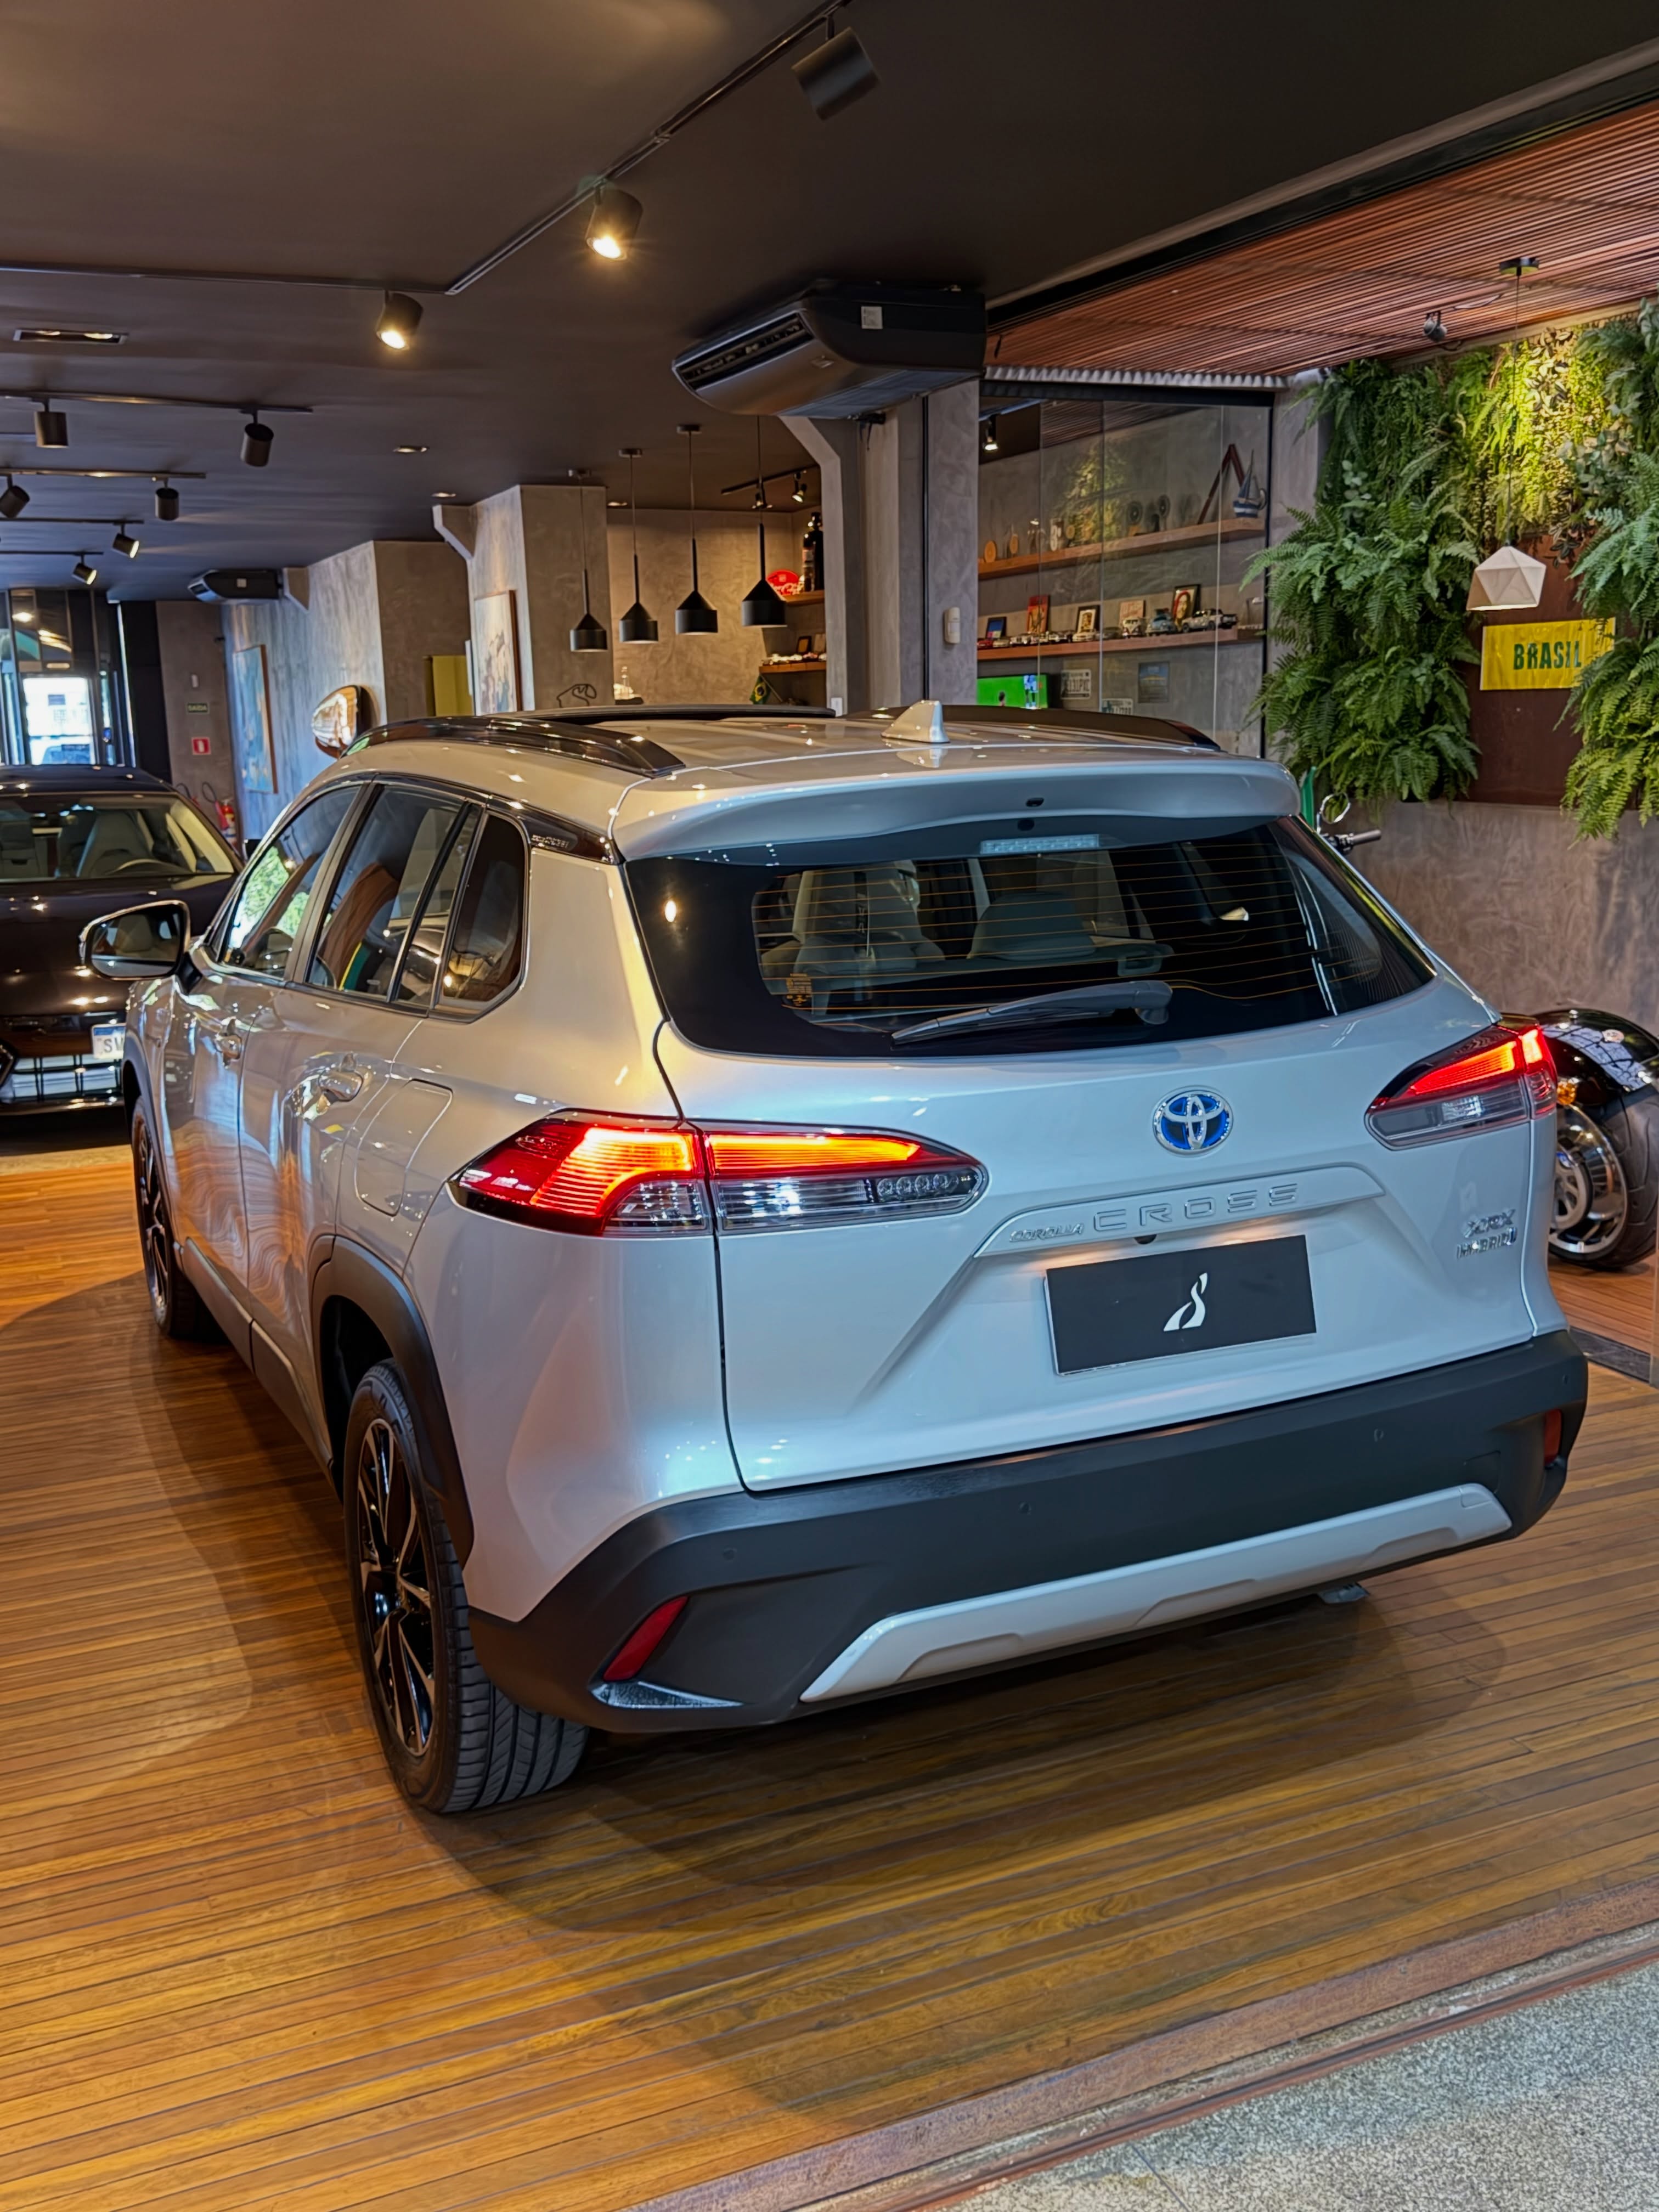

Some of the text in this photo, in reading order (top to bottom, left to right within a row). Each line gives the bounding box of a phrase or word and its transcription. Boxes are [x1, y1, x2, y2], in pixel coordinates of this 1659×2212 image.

[1513, 641, 1581, 670] BRASIL
[1009, 1183, 1297, 1242] COROLLA CROSS
